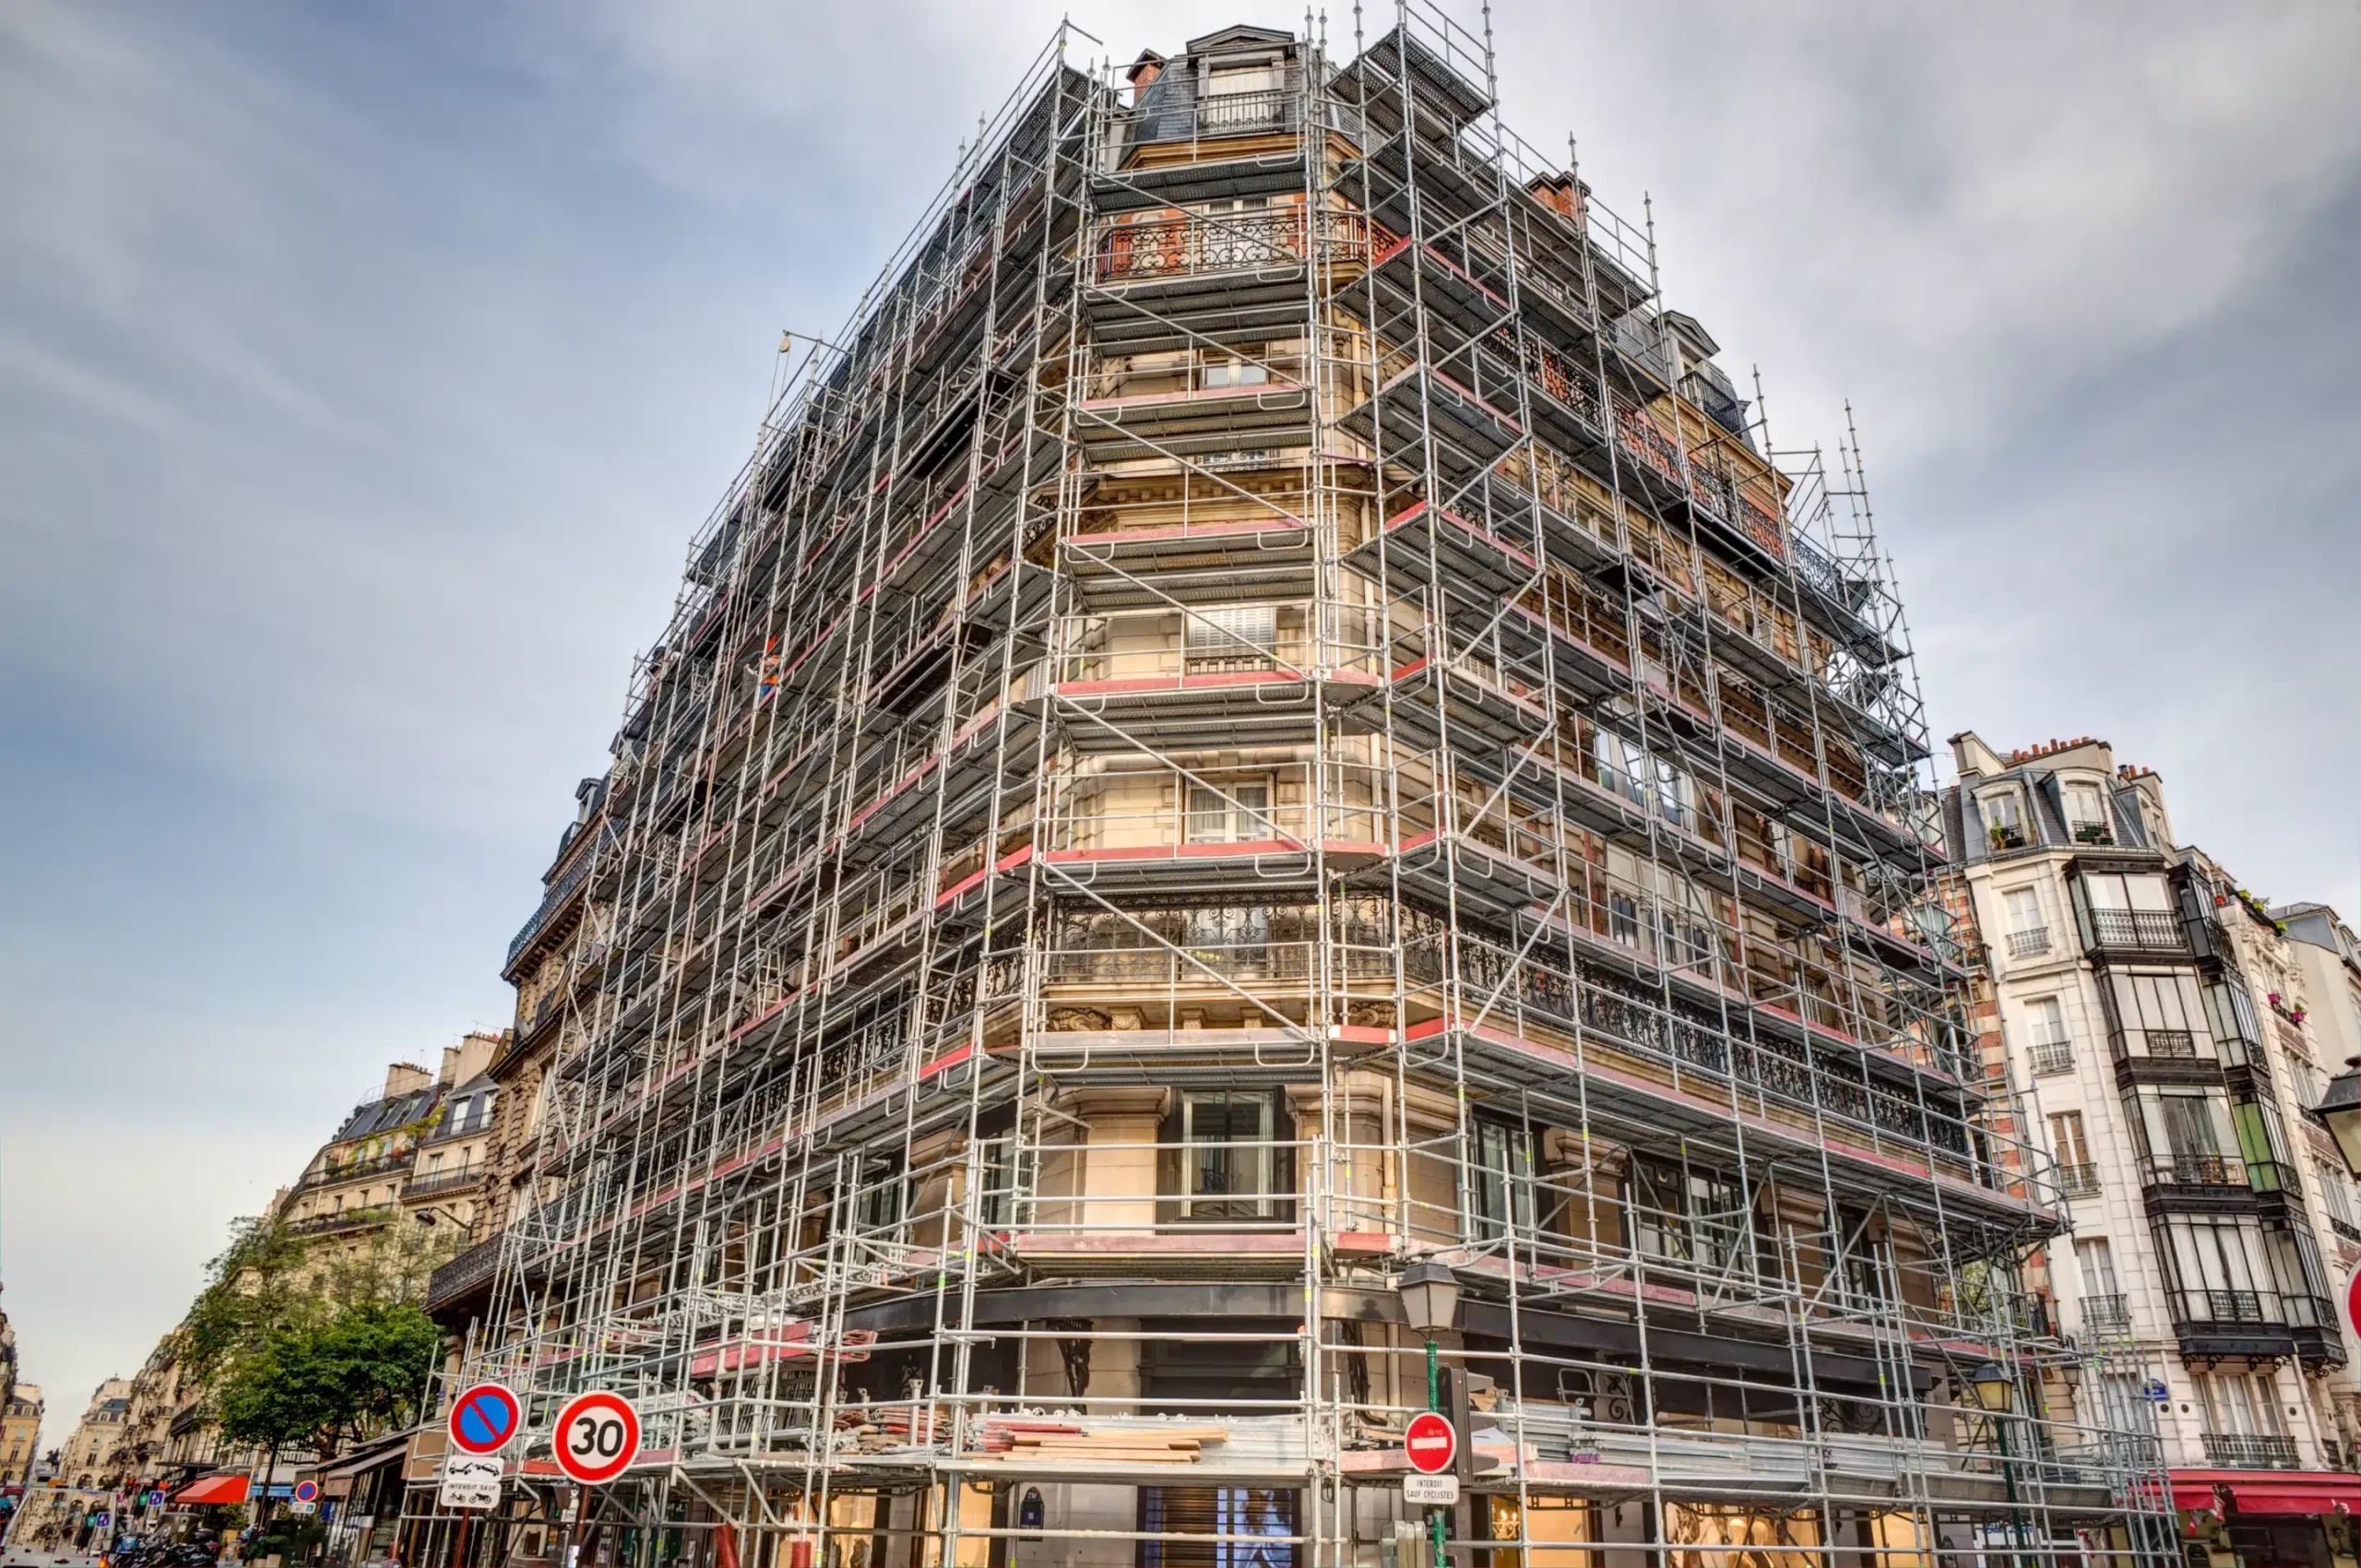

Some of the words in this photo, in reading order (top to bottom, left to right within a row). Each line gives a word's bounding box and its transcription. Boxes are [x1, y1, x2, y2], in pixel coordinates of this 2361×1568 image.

[571, 1417, 623, 1457] 30
[1417, 1479, 1442, 1488] INTERDIT
[1406, 1490, 1421, 1498] SAUF
[1423, 1491, 1453, 1499] CYCLISTES
